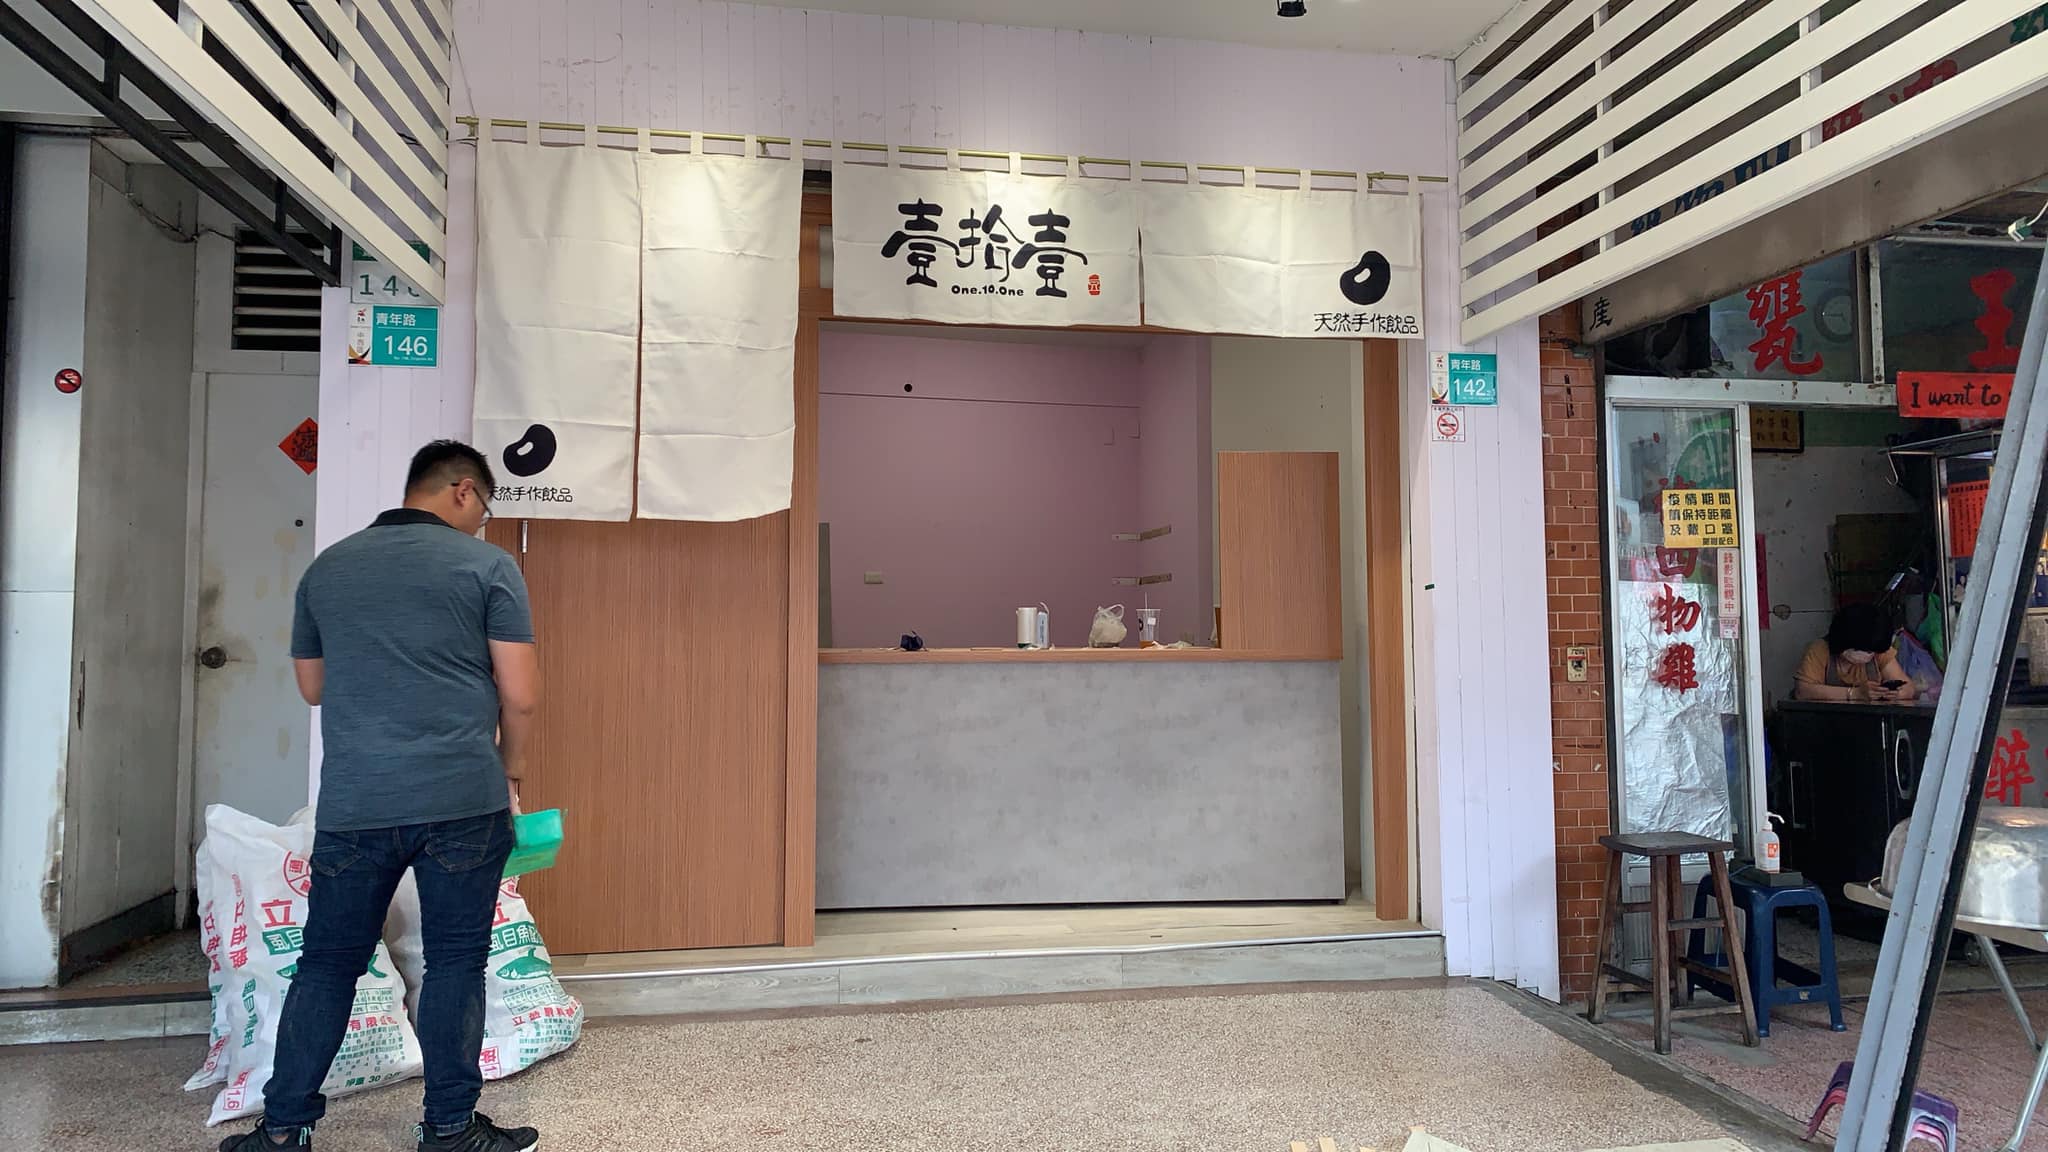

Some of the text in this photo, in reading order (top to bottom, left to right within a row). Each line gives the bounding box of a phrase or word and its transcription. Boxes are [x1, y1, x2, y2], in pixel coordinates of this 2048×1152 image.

[951, 284, 1024, 297] One.10.One
[376, 312, 416, 327] 青年路
[1314, 312, 1419, 335] 天然手作飲品
[384, 335, 428, 356] 146
[1451, 359, 1481, 371] 青年路
[1911, 381, 2002, 409] I want to
[1668, 492, 1731, 506] 疫情期間
[1668, 508, 1732, 521] 請保持距離
[1670, 523, 1733, 536] 及戴口罩
